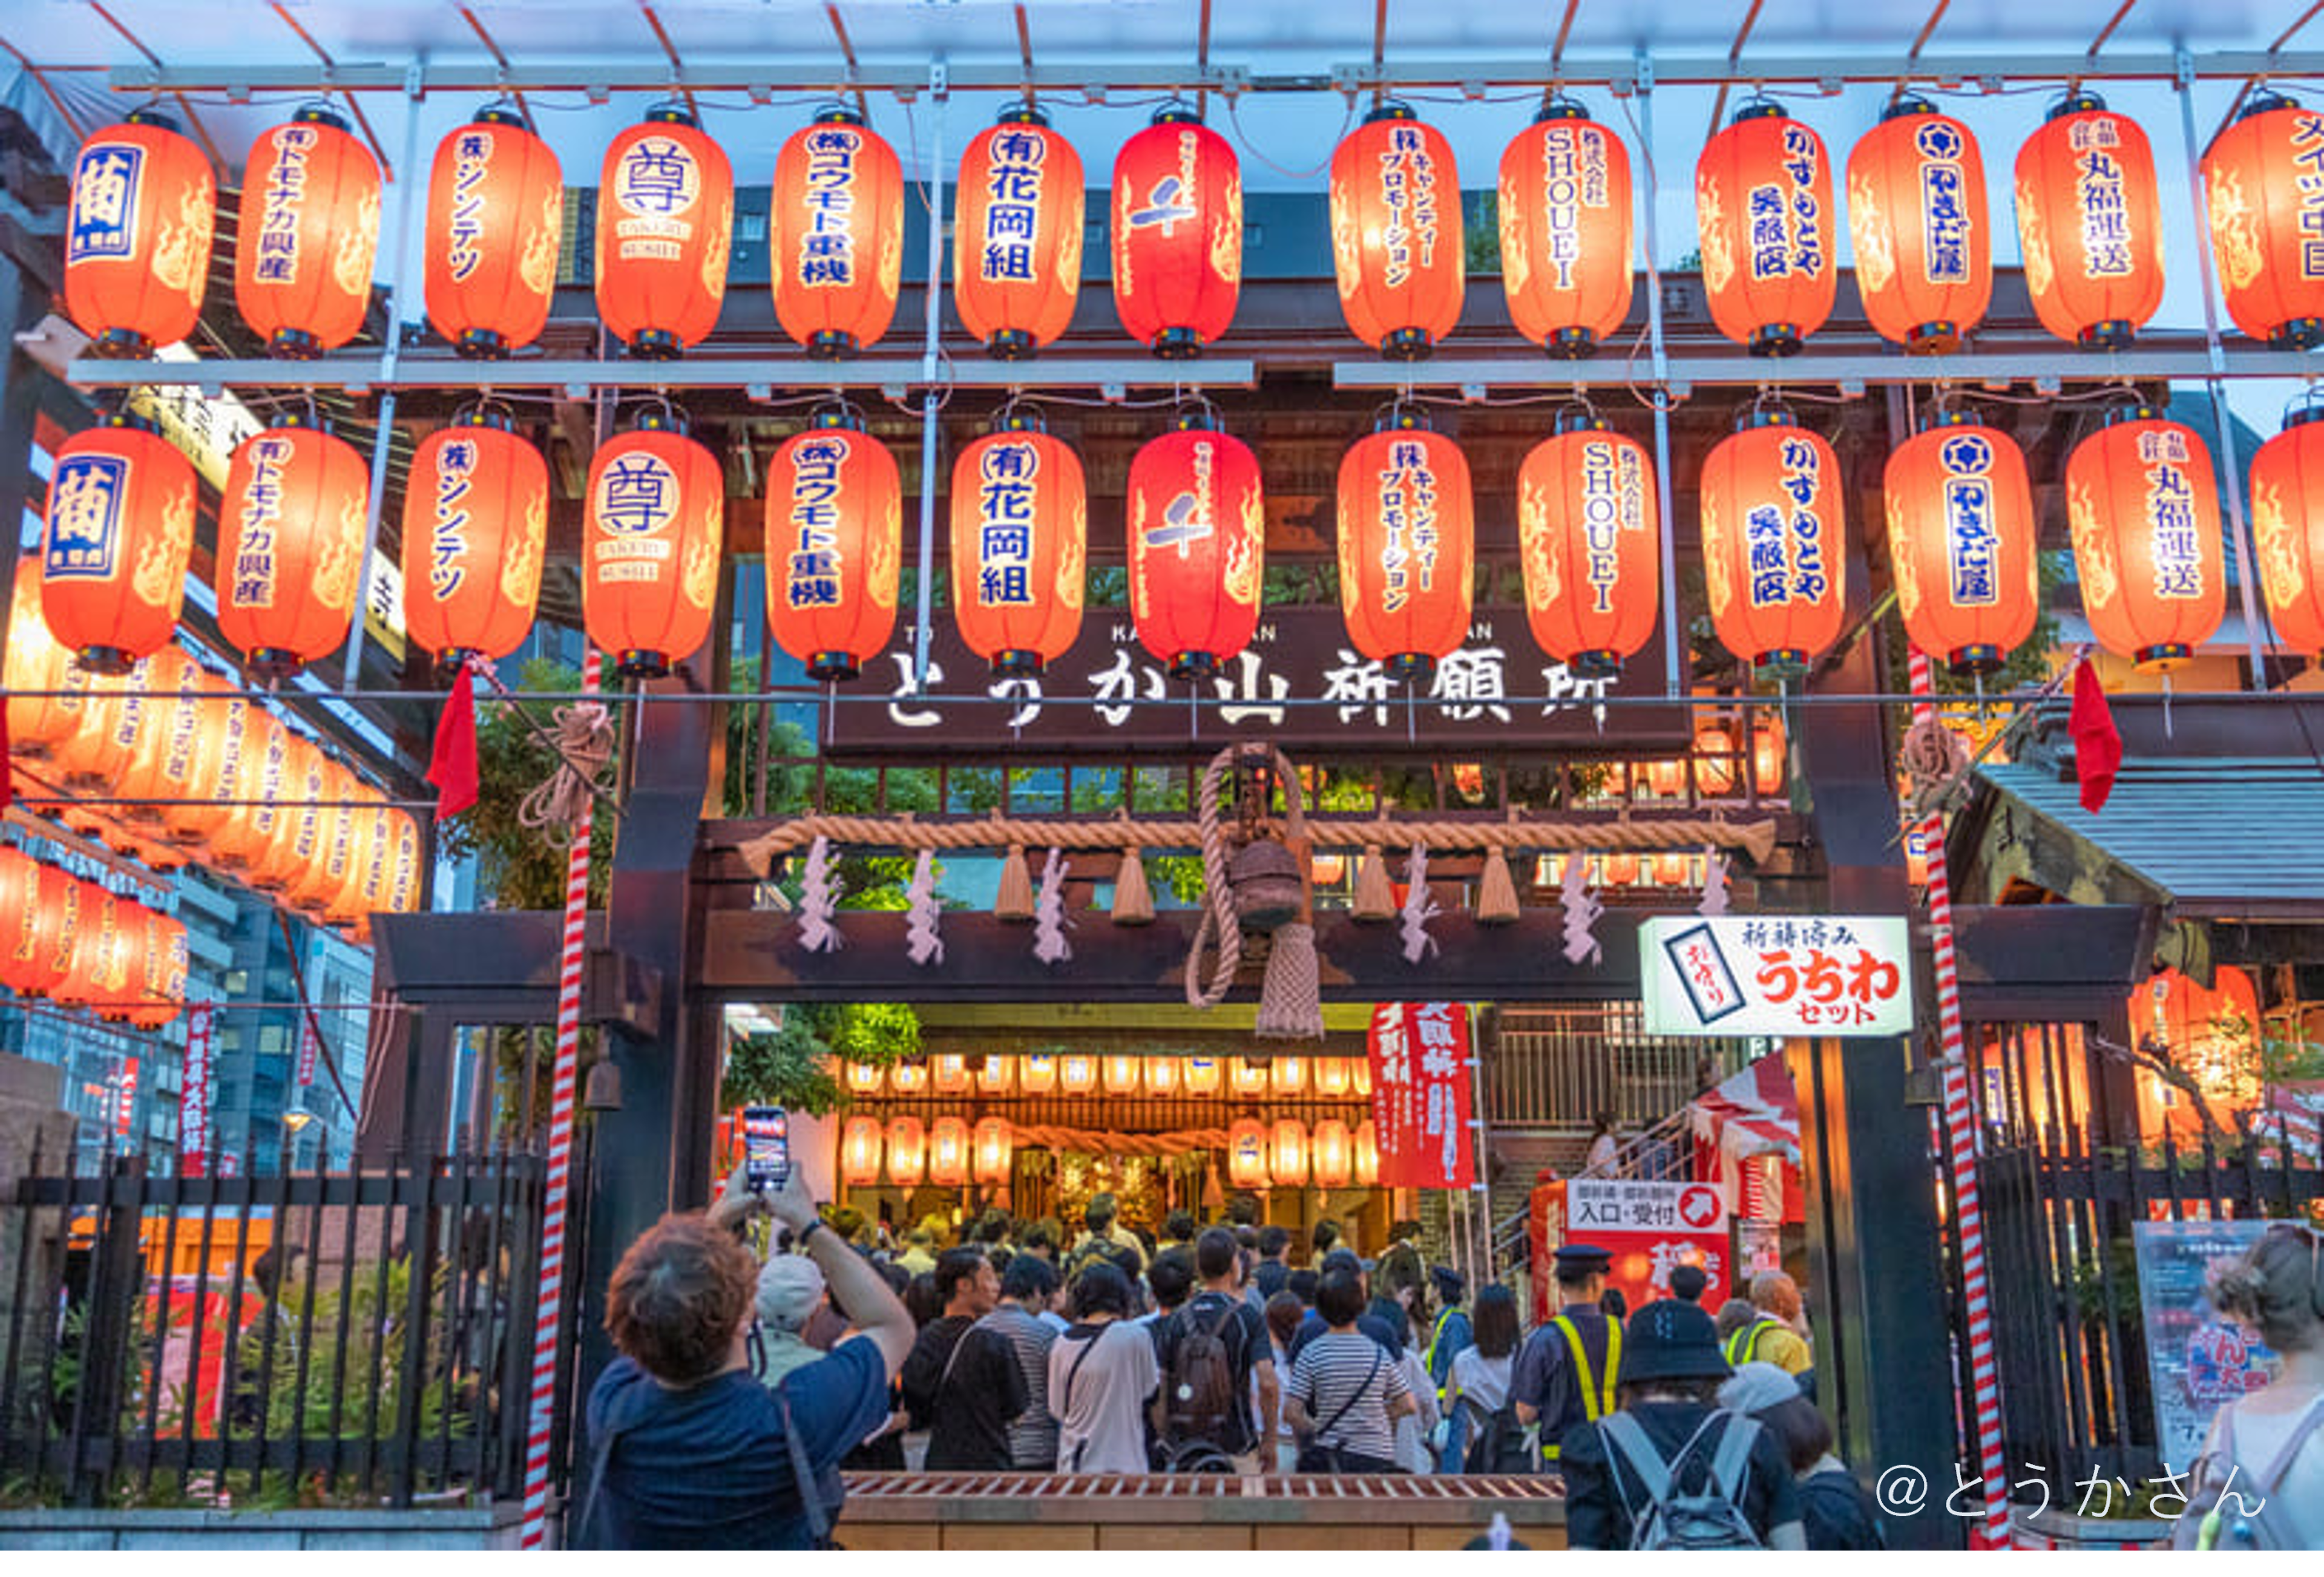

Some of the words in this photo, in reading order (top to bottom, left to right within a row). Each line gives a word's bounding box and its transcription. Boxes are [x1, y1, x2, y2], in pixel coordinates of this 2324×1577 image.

[1547, 130, 1575, 287] SHOUEI
[2081, 151, 2129, 275] 丸福運送
[1586, 444, 1616, 611] SHOUEI
[2153, 464, 2201, 596] 丸福運送
[1756, 949, 1899, 1003] うちわ
[1796, 1002, 1876, 1025] セット
[1578, 1201, 1675, 1225] 入口・受付
